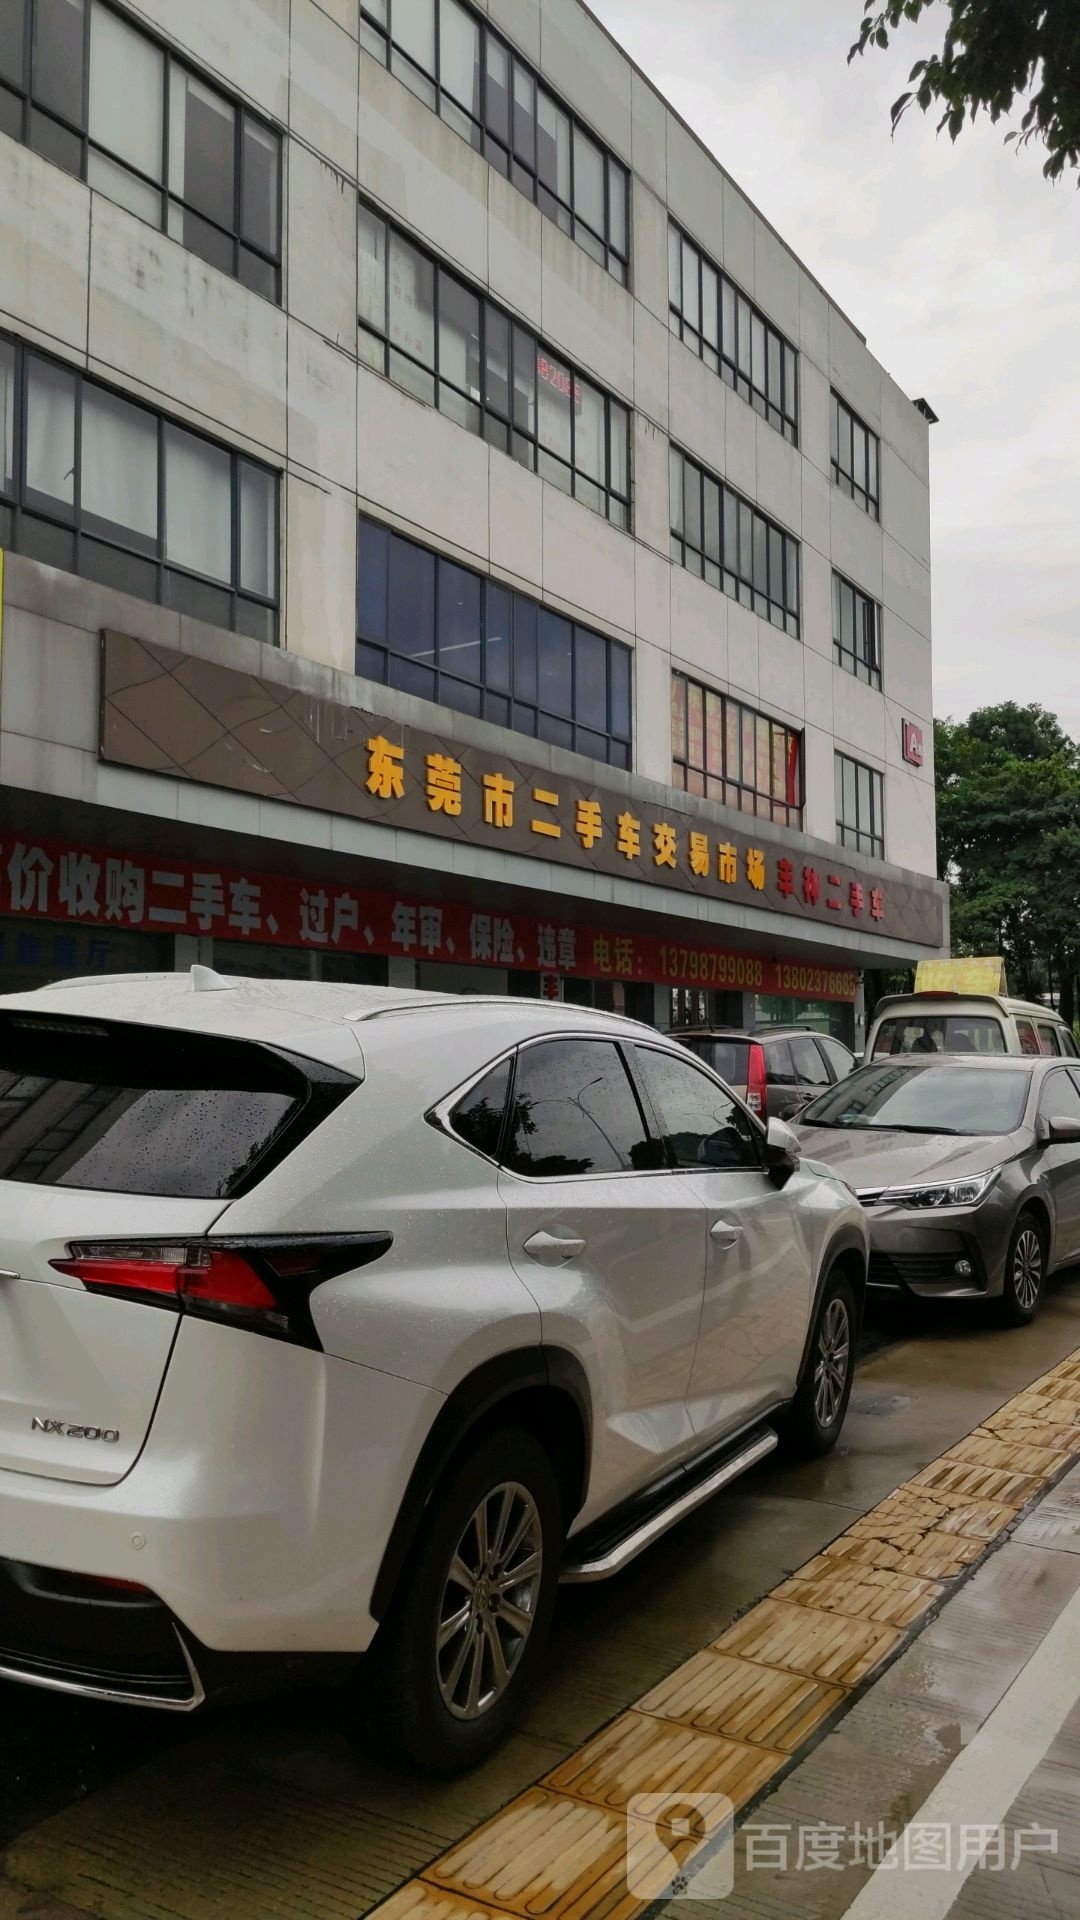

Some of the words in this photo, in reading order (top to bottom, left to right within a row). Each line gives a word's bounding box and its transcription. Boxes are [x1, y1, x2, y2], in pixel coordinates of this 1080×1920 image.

[366, 735, 766, 891] 东莞市二手车交易市场
[0, 841, 578, 970] 价收购二手车、过户、年审、保险、违章
